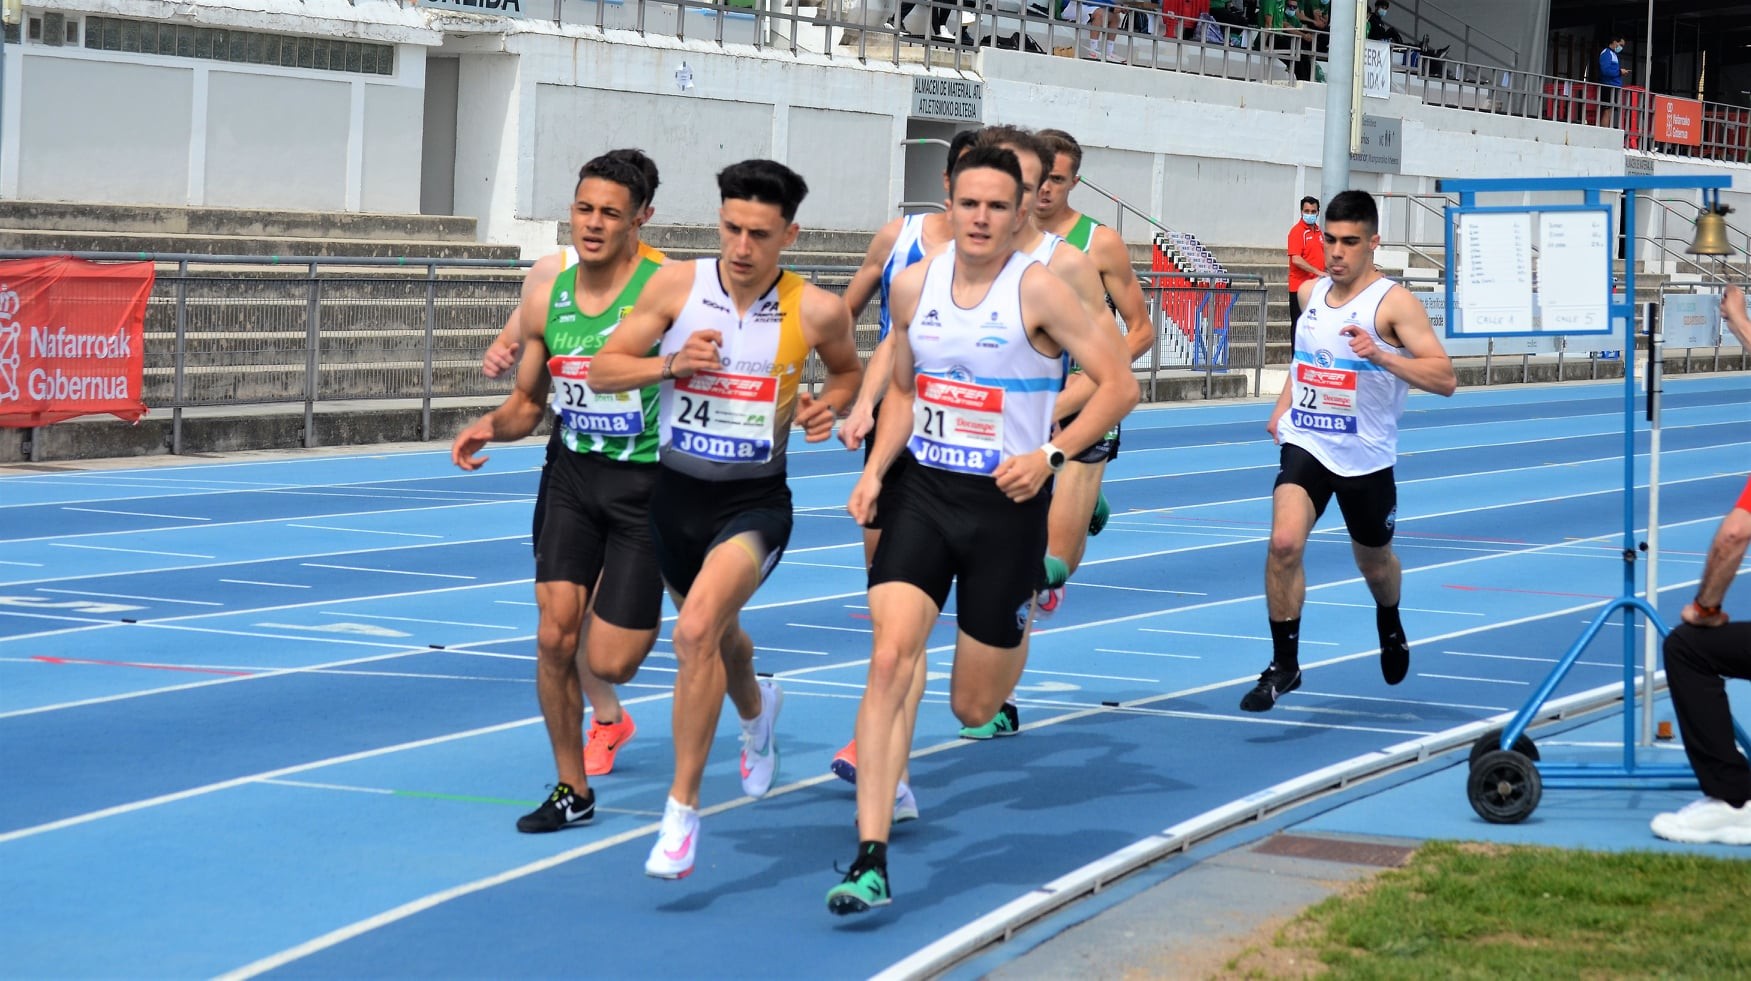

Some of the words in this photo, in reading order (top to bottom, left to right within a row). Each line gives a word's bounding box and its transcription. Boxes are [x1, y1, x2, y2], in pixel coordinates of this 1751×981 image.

[940, 80, 947, 96] DE
[947, 81, 972, 98] MATERIAL
[1364, 72, 1380, 90] IDA
[1584, 312, 1597, 325] 5
[553, 332, 609, 350] Hues
[28, 367, 129, 401] Gobernua
[562, 381, 588, 408] 32
[1299, 386, 1317, 410] 22
[677, 395, 711, 428] 24
[923, 406, 945, 438] 21
